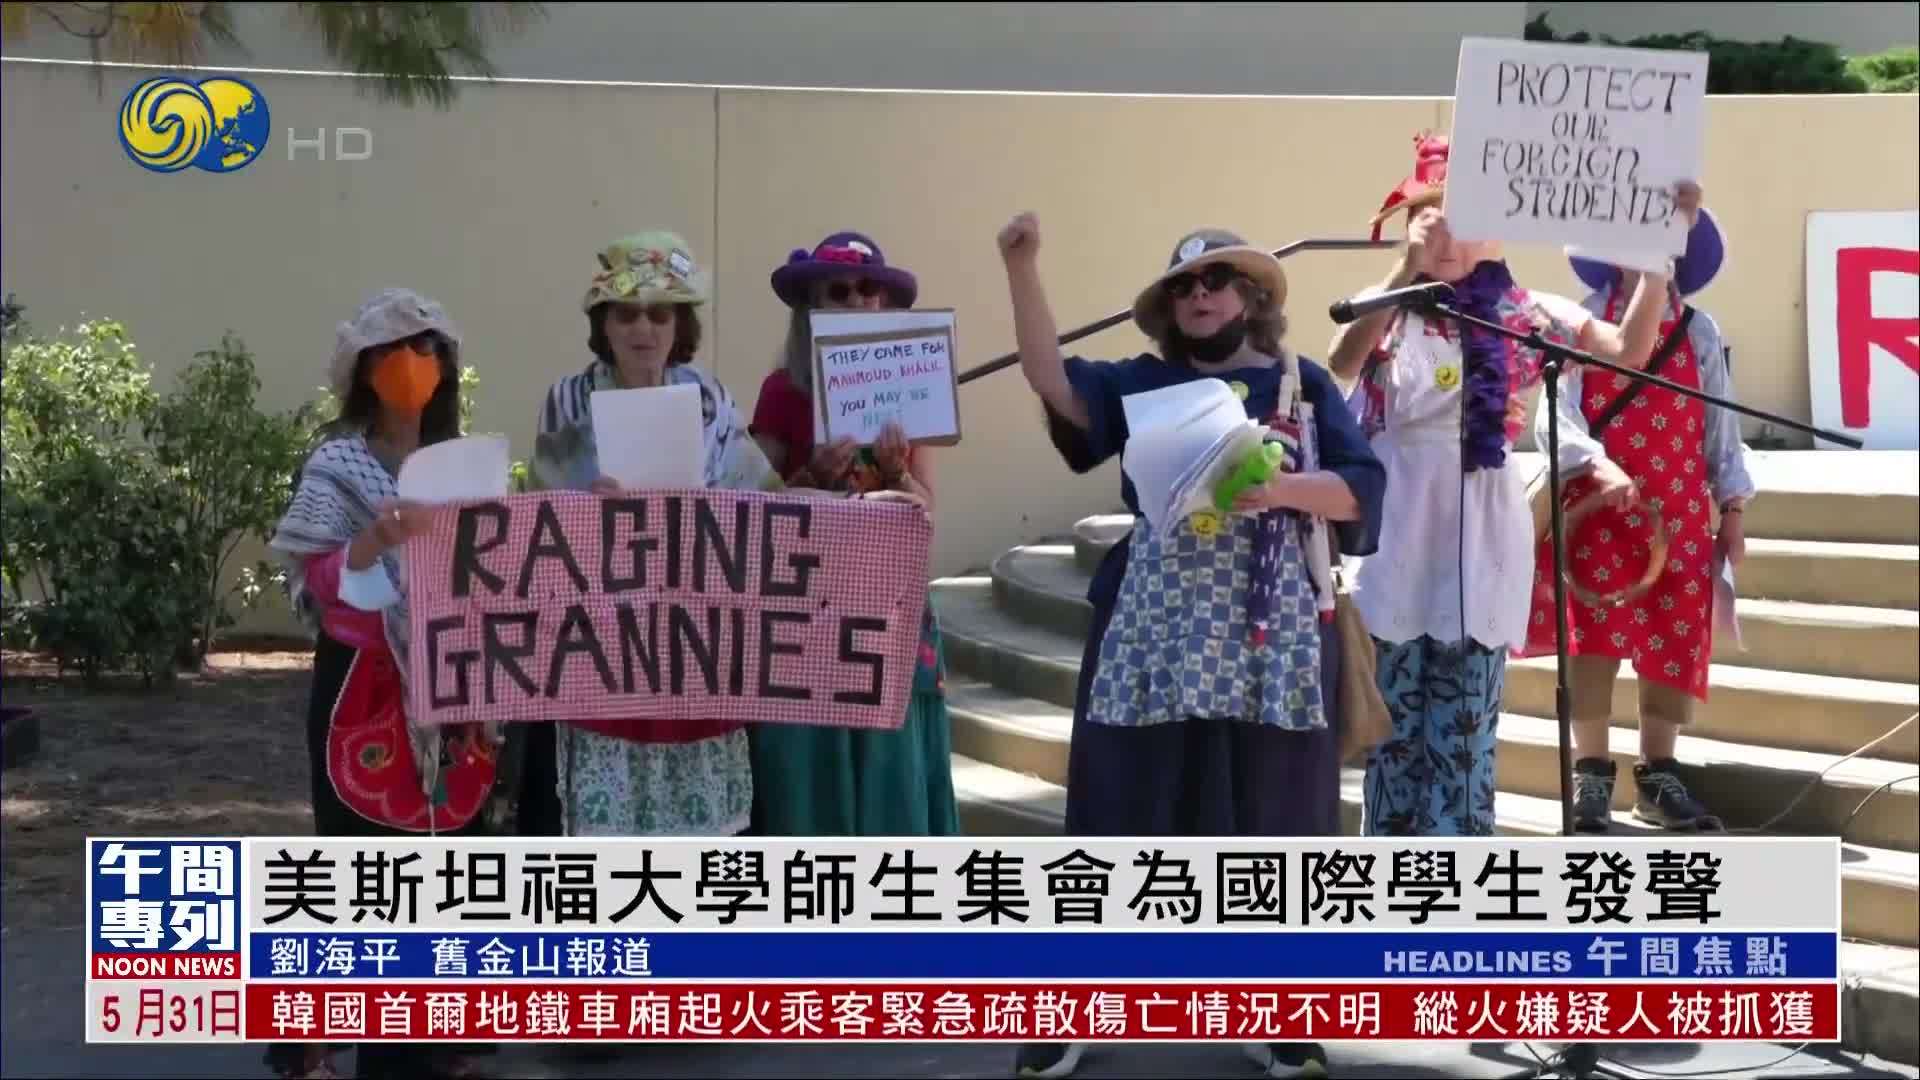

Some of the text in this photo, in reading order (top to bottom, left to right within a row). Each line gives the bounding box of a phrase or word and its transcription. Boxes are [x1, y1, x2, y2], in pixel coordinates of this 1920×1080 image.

[1496, 61, 1691, 115] PROTECT
[1551, 111, 1609, 143] OUR
[827, 341, 945, 366] THEY CAME FOR
[827, 368, 892, 392] MAHMOUD
[840, 399, 866, 417] YOU
[873, 390, 901, 408] MAY
[451, 496, 821, 598] RAGING
[425, 602, 888, 710] GRANNIES
